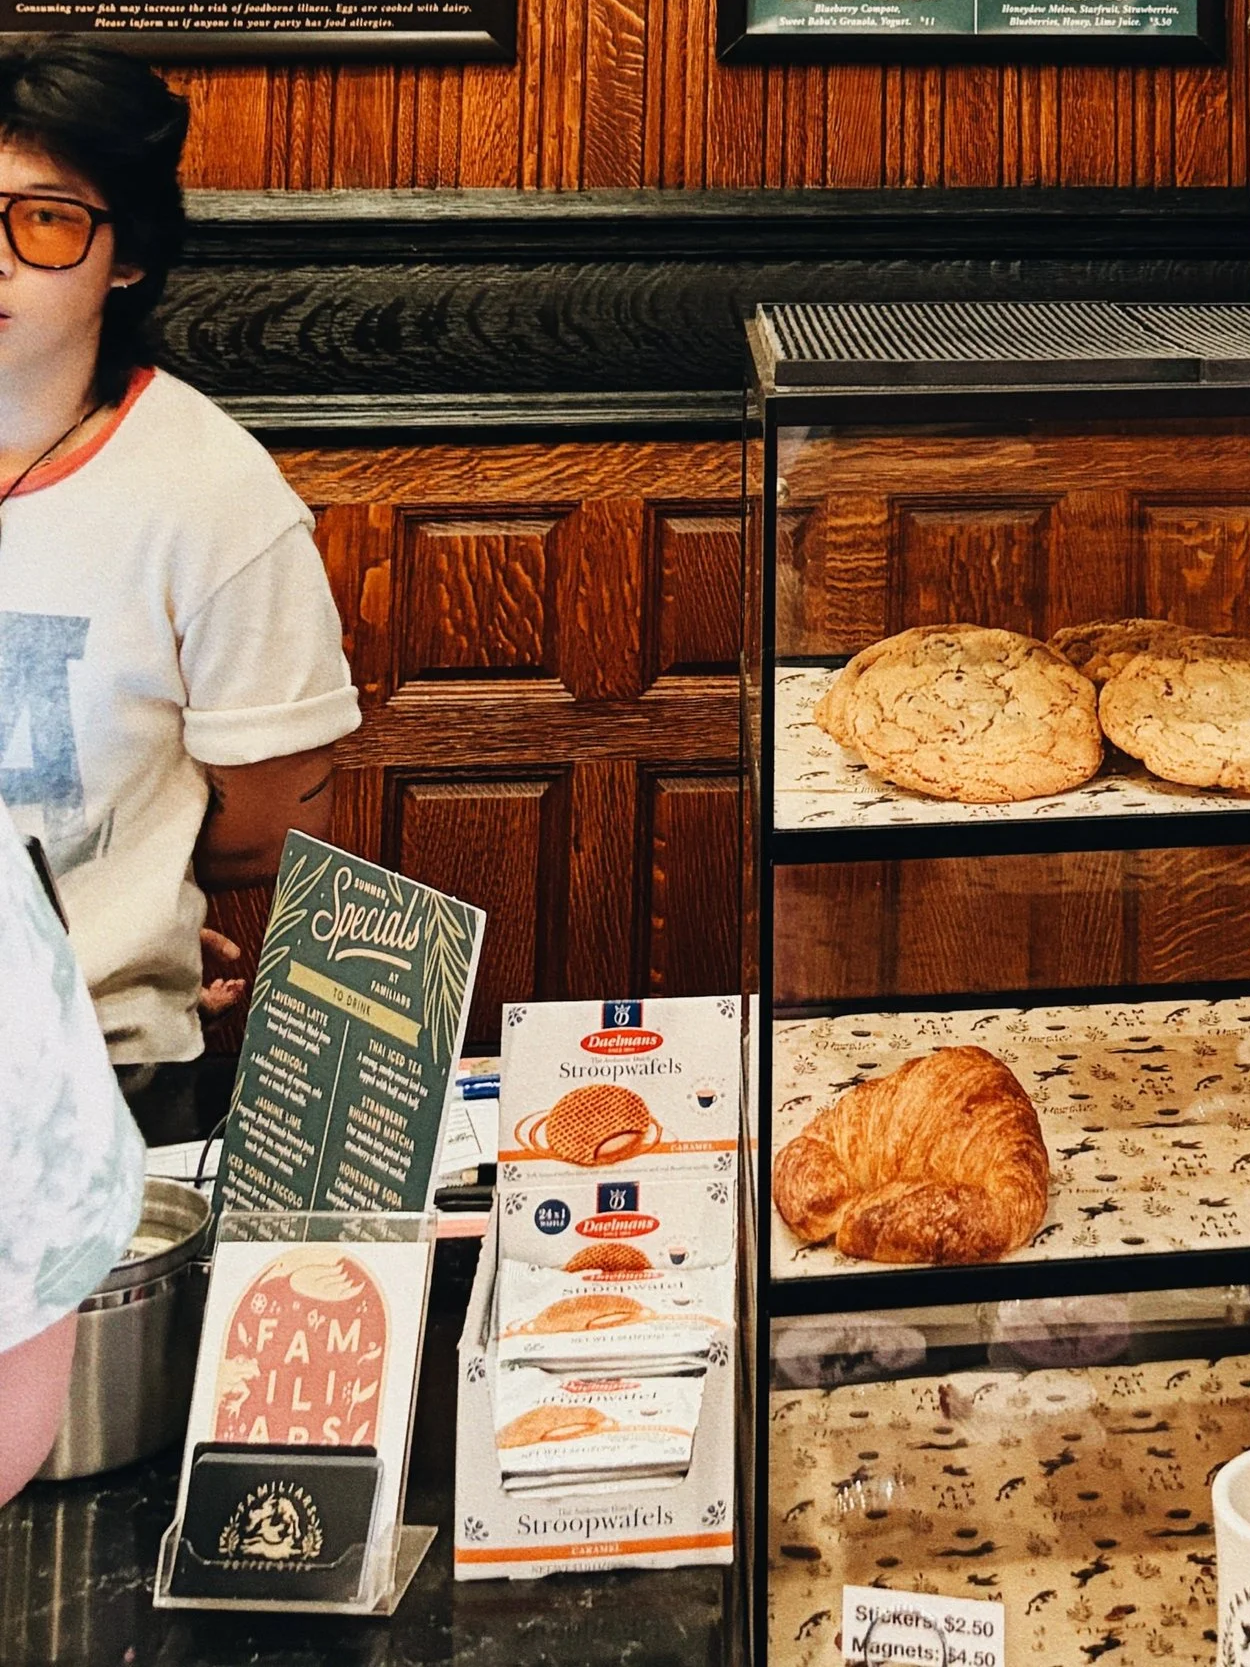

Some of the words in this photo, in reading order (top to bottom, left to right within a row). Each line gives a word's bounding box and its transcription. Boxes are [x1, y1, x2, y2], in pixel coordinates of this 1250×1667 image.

[355, 877, 387, 900] SUMMER
[311, 866, 423, 961] Specials
[388, 971, 400, 984] AT
[333, 986, 344, 1002] TO
[346, 995, 372, 1016] DRINK
[587, 1034, 658, 1048] Daelmans
[559, 1057, 683, 1082] Stroopwafels
[583, 1217, 654, 1233] Daelmans
[517, 1505, 674, 1539] Stroopwafels
[943, 1616, 995, 1638] $2.50
[851, 1636, 940, 1662] Magnets:
[947, 1646, 996, 1667] $4.50
